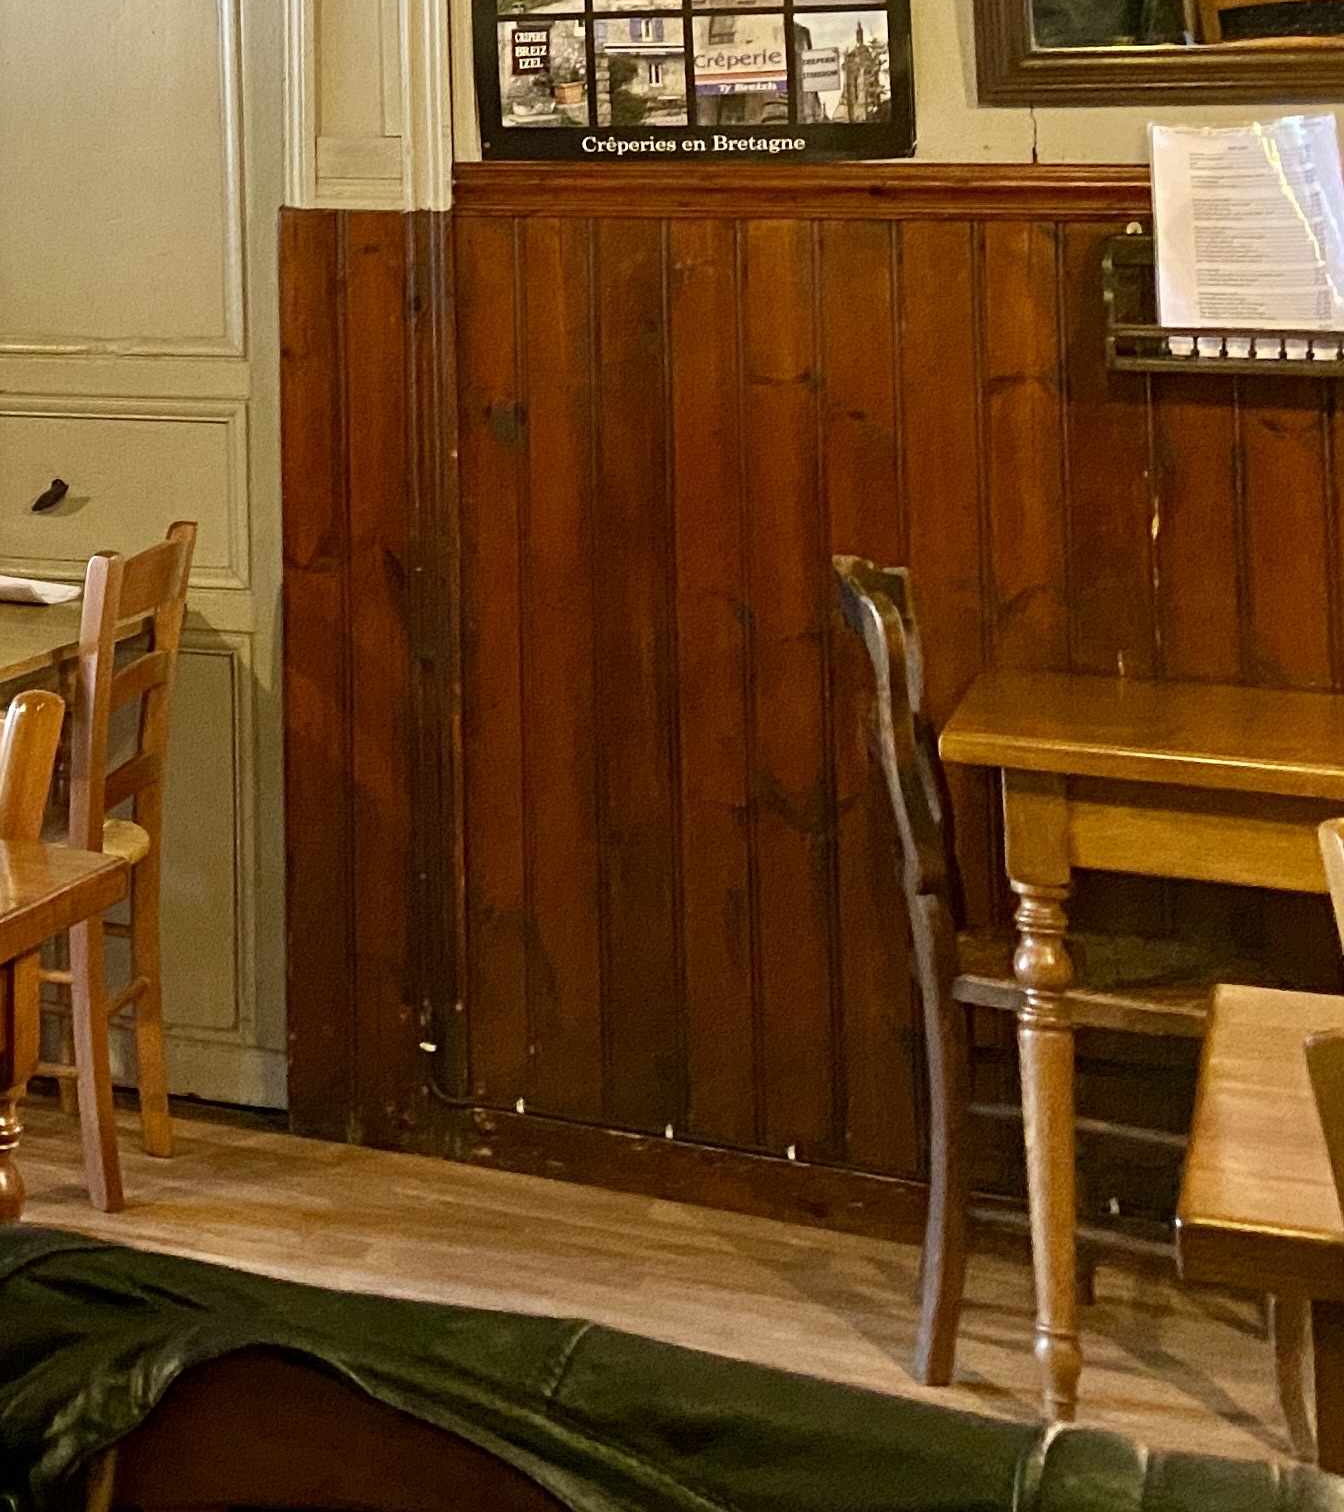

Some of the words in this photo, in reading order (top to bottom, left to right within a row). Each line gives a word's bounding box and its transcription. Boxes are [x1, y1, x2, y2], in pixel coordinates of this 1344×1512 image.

[515, 45, 547, 58] BREIZ
[694, 49, 782, 71] Crêperie
[519, 58, 544, 70] IZEL
[581, 136, 677, 156] Crêperies
[681, 139, 706, 152] en
[713, 135, 806, 154] Bretagne
